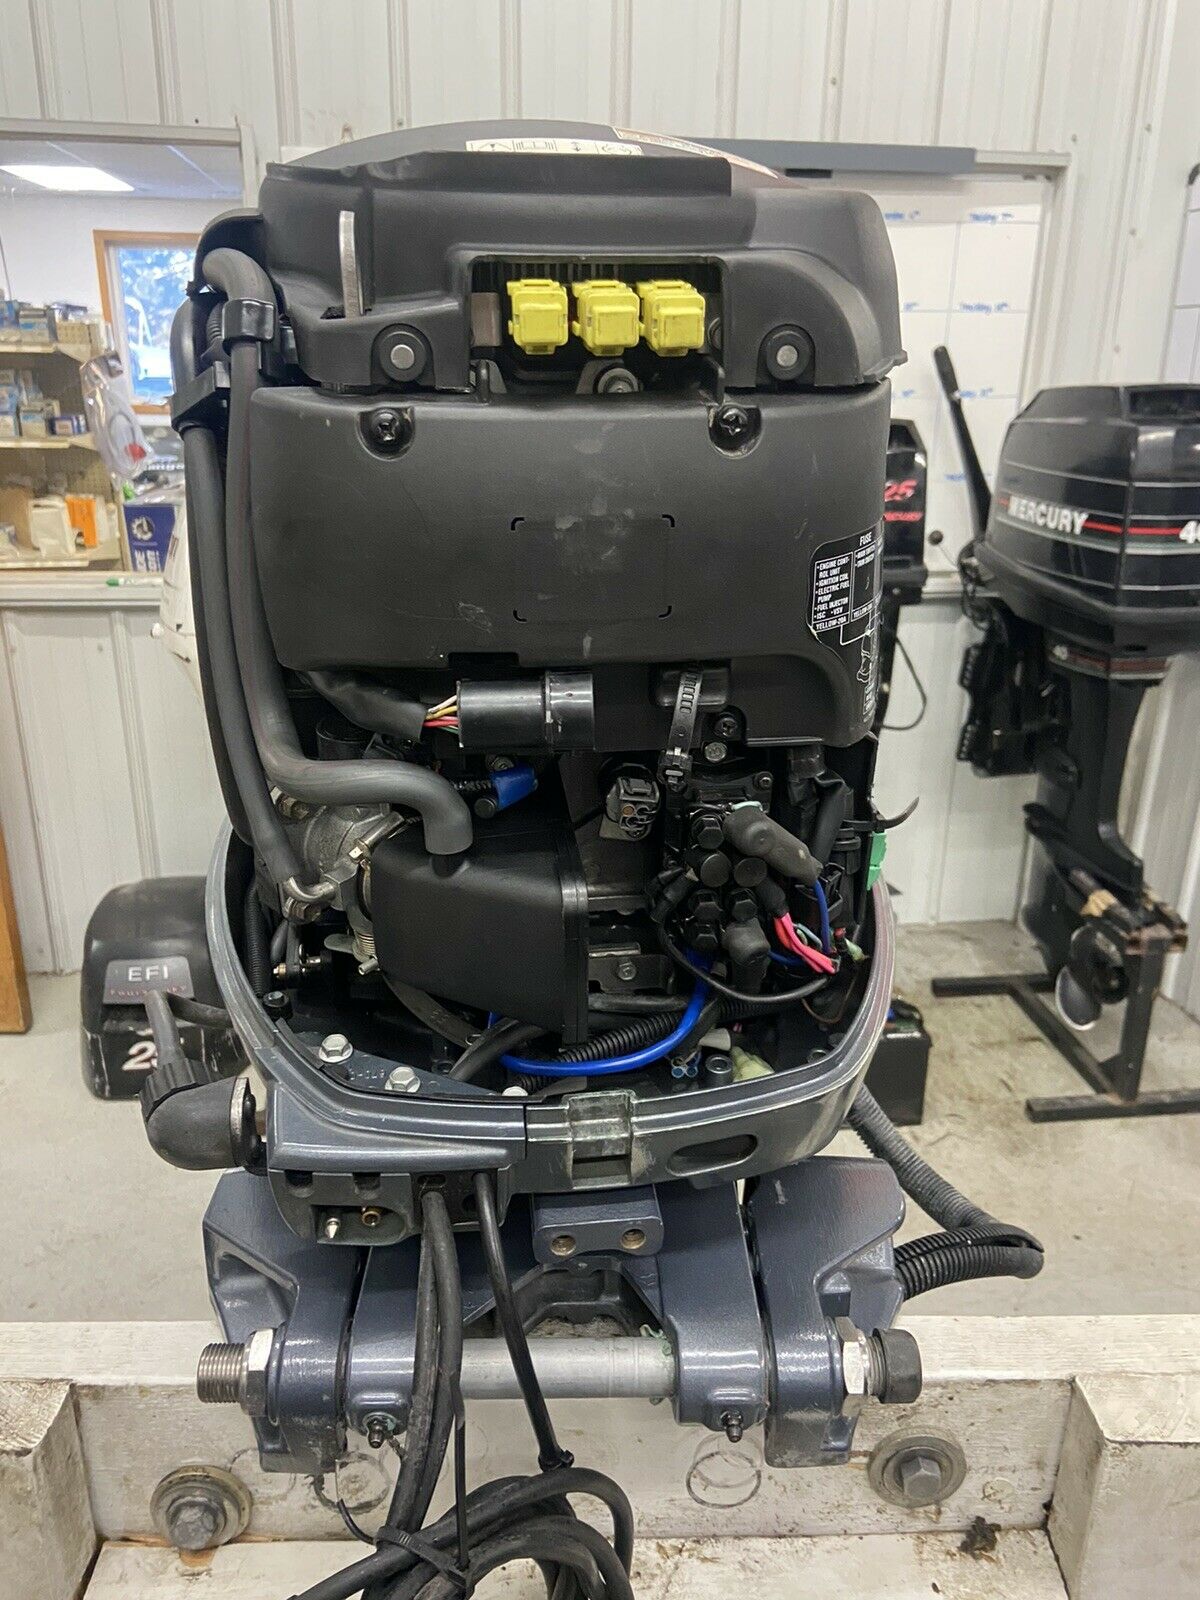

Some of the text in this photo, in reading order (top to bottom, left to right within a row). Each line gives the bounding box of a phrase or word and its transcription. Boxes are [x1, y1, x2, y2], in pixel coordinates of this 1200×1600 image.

[1008, 495, 1089, 535] MERCURY
[860, 532, 872, 546] FUSE
[819, 560, 836, 570] ENGINE
[829, 567, 841, 576] UNIT
[818, 576, 839, 587] IGNITION
[818, 580, 850, 596] ELECTRIC FUEL
[817, 593, 832, 604] PUMP
[817, 597, 849, 612] FUEL INJECTOR
[128, 964, 169, 982] EFI
[121, 1040, 158, 1072] 2
